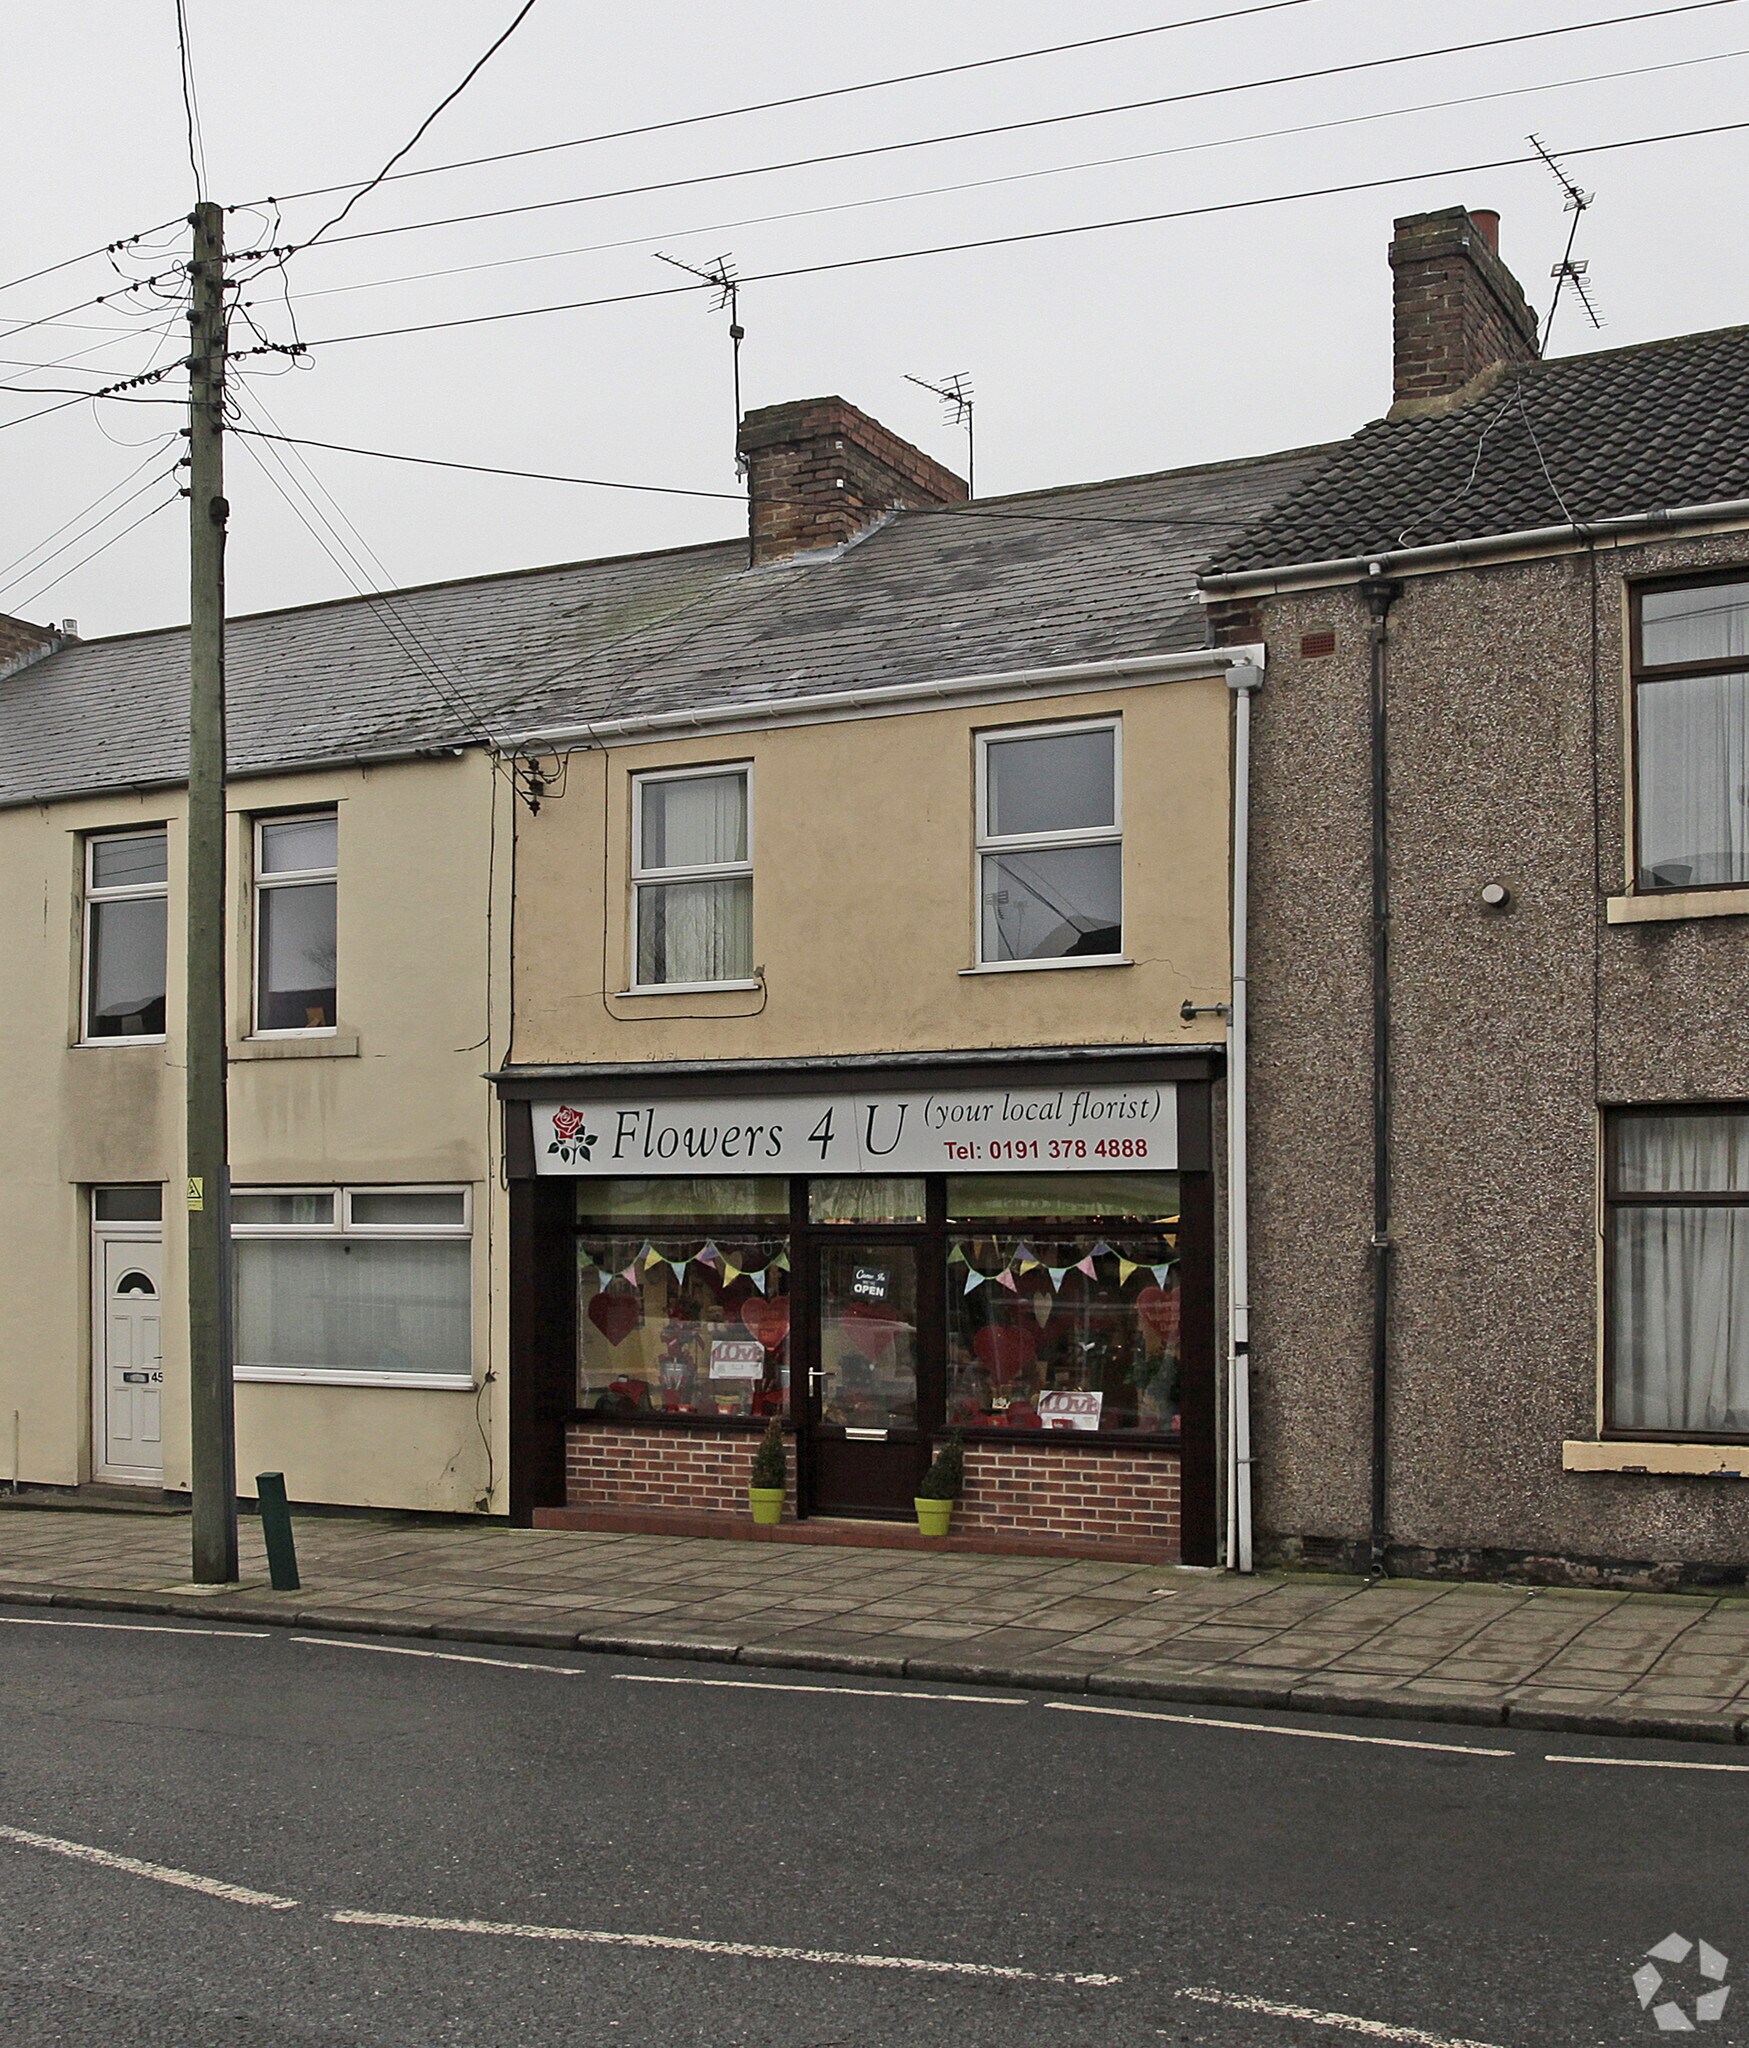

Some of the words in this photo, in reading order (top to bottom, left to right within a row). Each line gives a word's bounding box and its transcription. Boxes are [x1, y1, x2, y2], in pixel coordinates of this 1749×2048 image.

[923, 1096, 993, 1129] (your
[1002, 1092, 1063, 1121] local
[1068, 1089, 1161, 1126] florist)
[612, 1107, 783, 1159] Flowers
[807, 1105, 835, 1160] 4
[865, 1103, 909, 1156] U
[944, 1141, 981, 1160] Tel:
[989, 1140, 1039, 1159] 0191
[1048, 1139, 1087, 1158] 378
[1094, 1138, 1148, 1158] 4888
[853, 1283, 885, 1297] OPEN
[151, 1371, 164, 1383] 45
